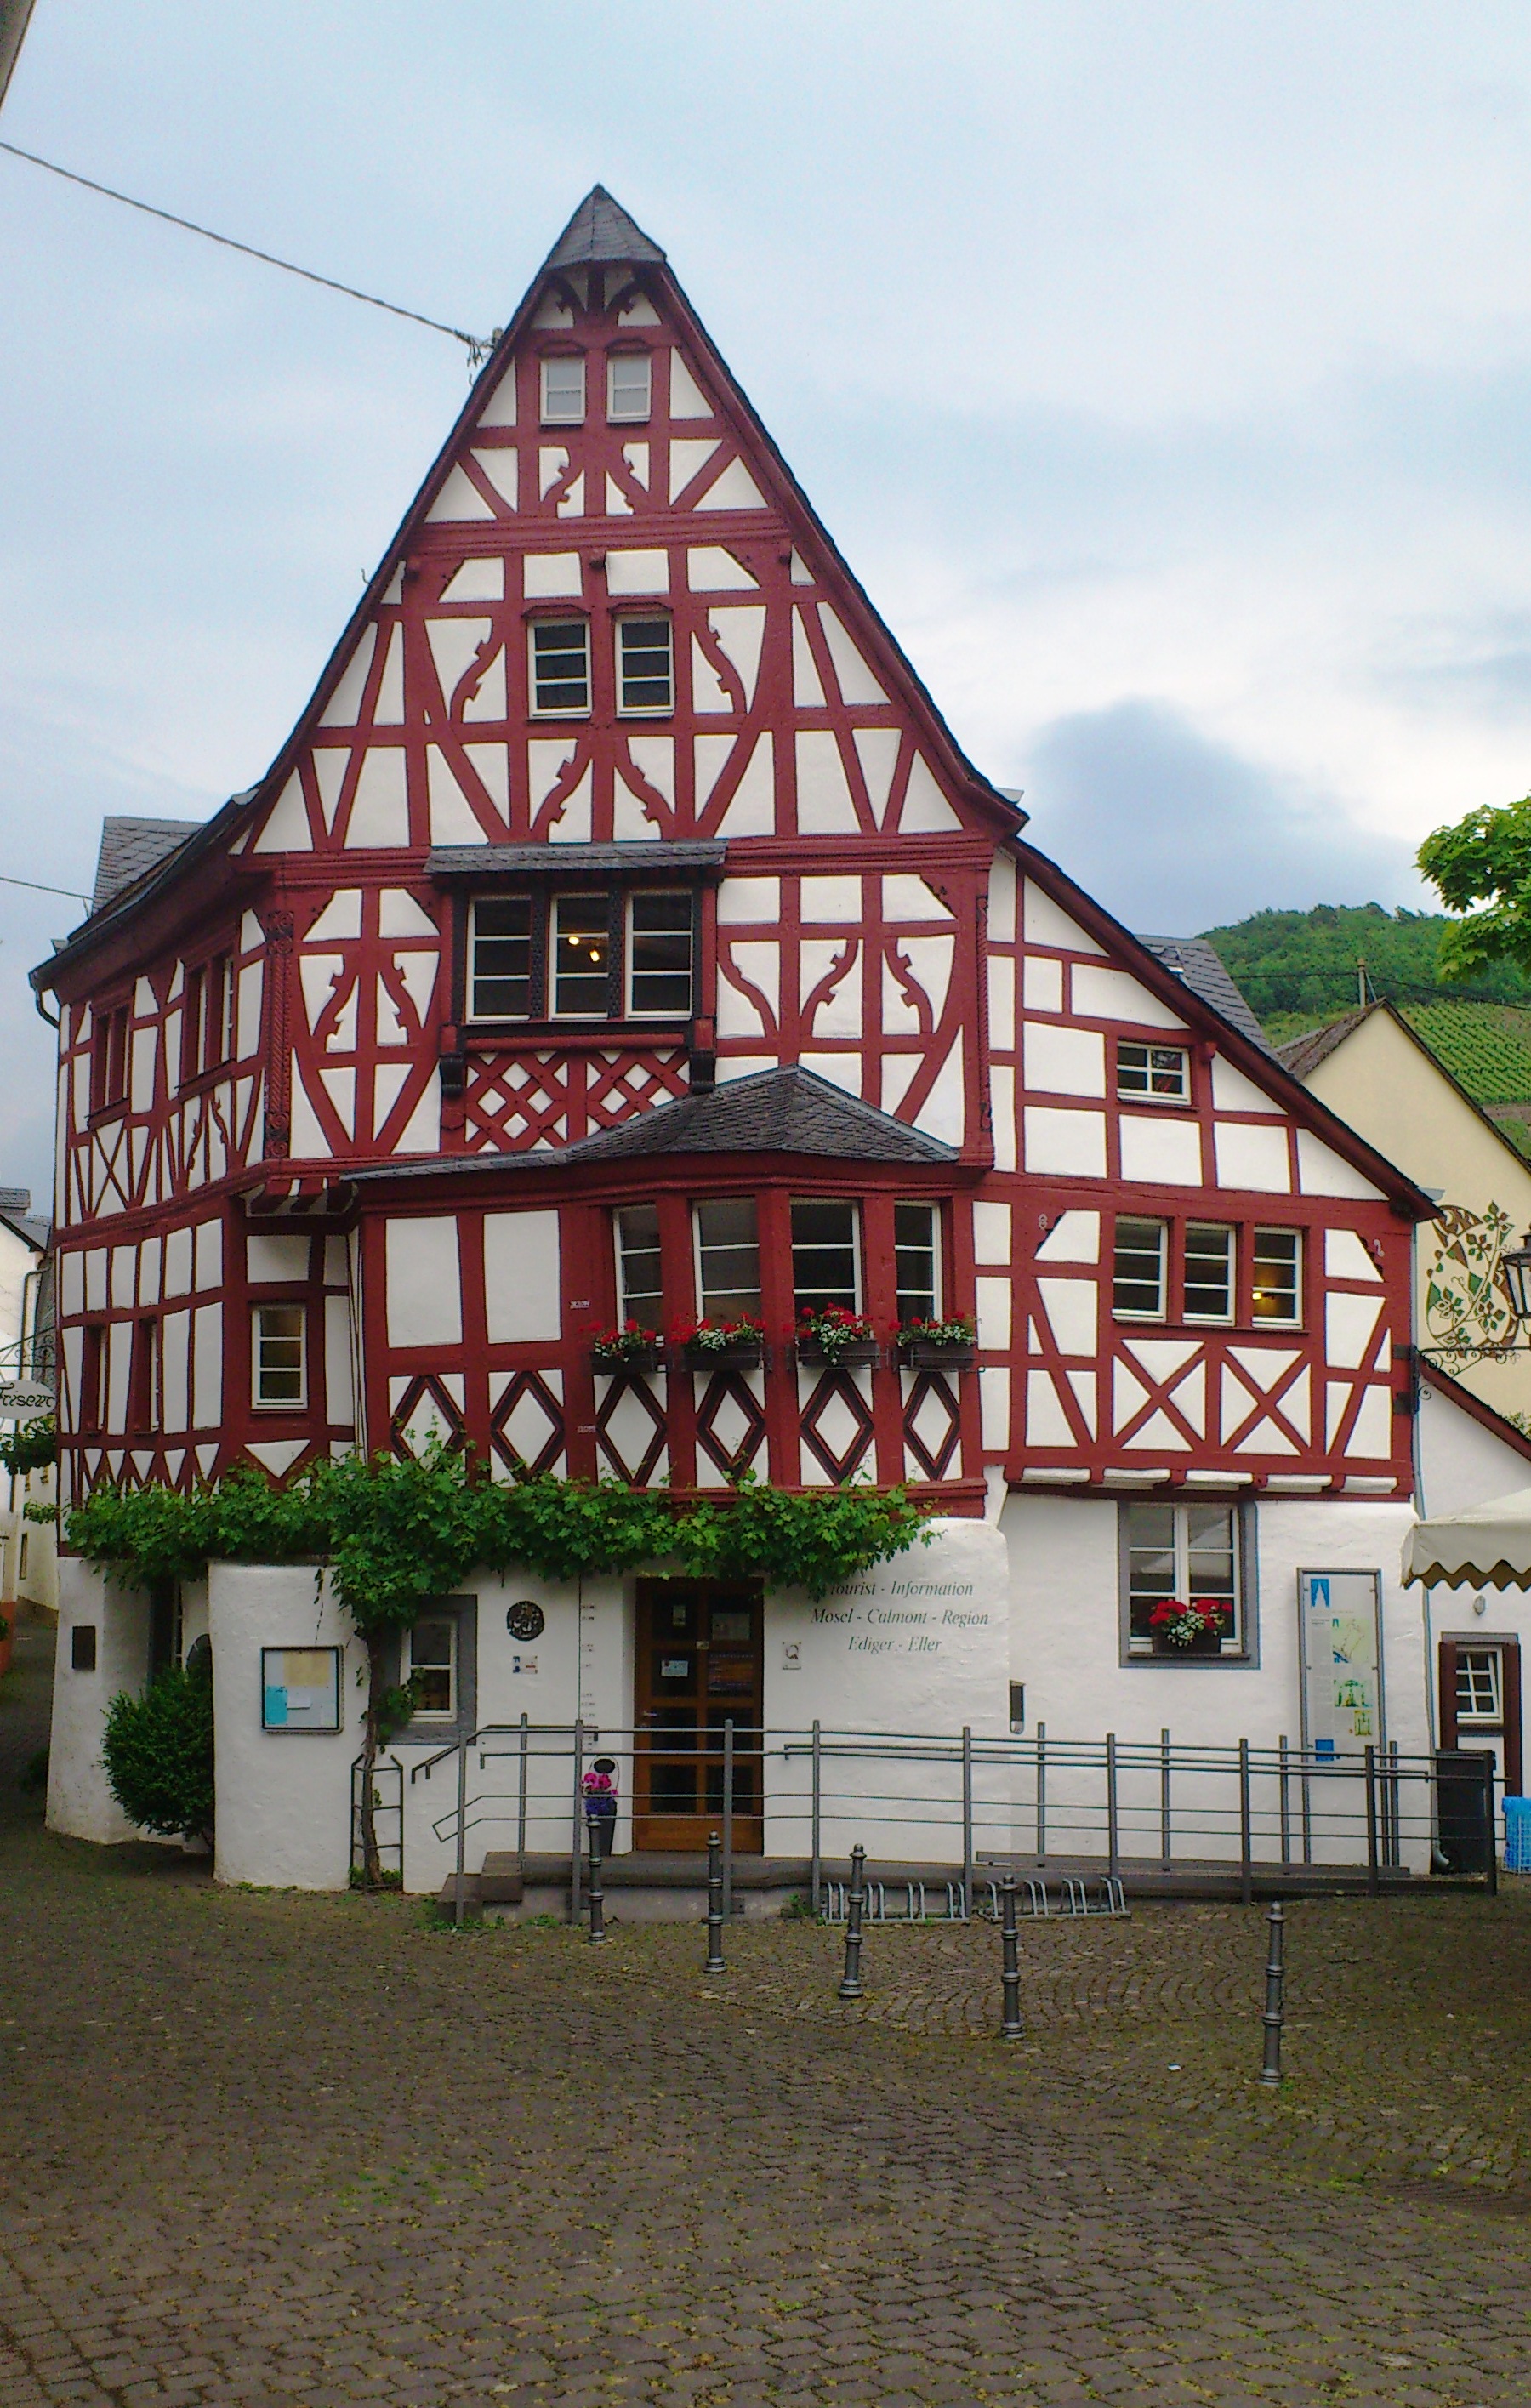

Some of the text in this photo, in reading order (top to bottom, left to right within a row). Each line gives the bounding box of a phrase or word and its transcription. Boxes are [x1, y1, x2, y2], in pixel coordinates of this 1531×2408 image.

[891, 1580, 974, 1597] Information
[811, 1608, 854, 1624] Mosel
[868, 1608, 928, 1624] Calmont
[942, 1609, 989, 1628] Region
[848, 1636, 895, 1654] Ediger
[908, 1636, 942, 1652] Eller
